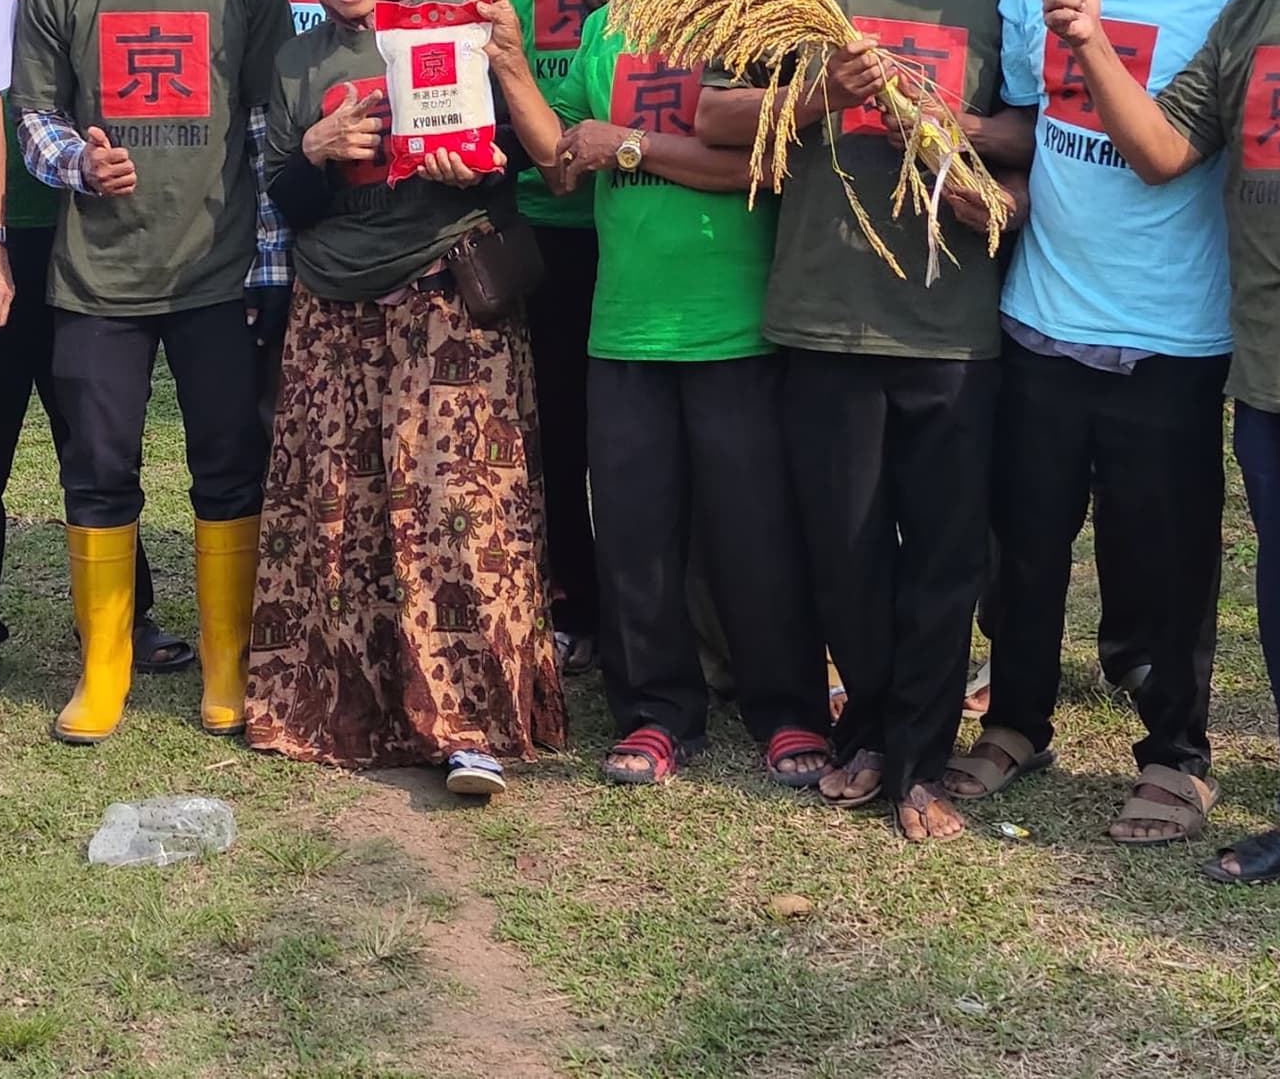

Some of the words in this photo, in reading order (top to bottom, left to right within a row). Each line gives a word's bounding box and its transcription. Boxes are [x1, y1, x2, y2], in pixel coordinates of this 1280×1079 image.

[116, 26, 193, 102] 京
[420, 51, 448, 80] 京
[536, 58, 573, 79] KYO
[413, 113, 463, 129] KYOHIKARI
